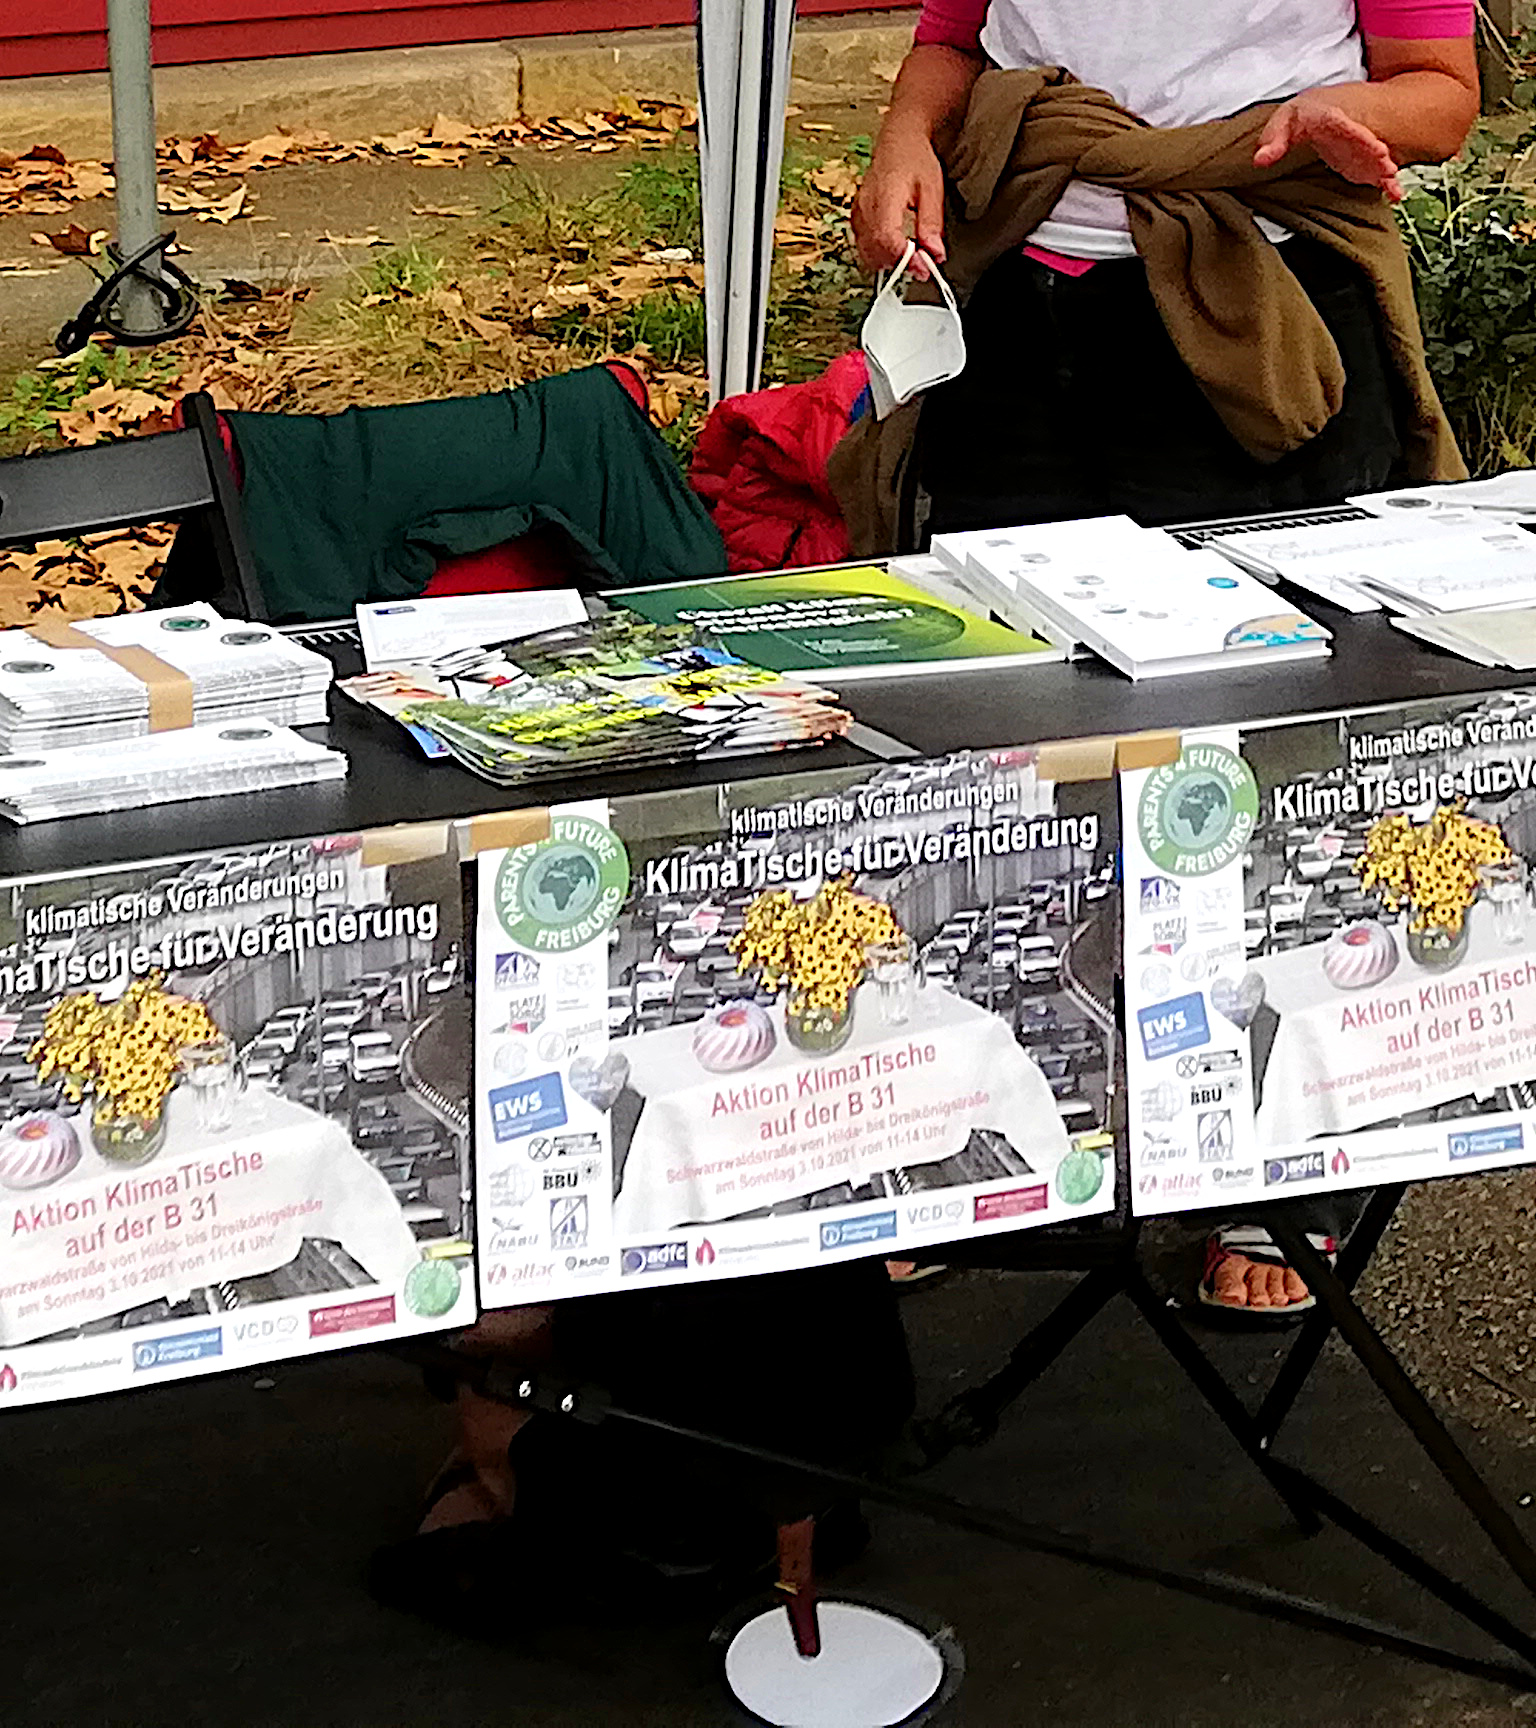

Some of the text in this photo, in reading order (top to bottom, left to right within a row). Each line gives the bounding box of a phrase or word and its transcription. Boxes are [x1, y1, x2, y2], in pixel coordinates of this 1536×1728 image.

[1349, 724, 1463, 762] klimatische
[730, 782, 1019, 836] klimatische Veränderungen
[1142, 748, 1247, 853] PARENTS FUTURE
[1273, 765, 1455, 822] KlimaTische
[553, 820, 618, 865] FUTURE
[645, 840, 842, 896] KlimaTische
[903, 813, 1100, 863] Veränderung
[1174, 810, 1251, 872] FREIBURG
[25, 870, 345, 936] klimatische Veränderungen
[217, 900, 439, 961] Veränderung
[534, 885, 621, 950] FREIBURG
[1142, 1009, 1188, 1042] EWS
[1339, 996, 1412, 1033] Aktion
[1386, 998, 1515, 1055] auf der B 31
[493, 1090, 543, 1122] EWS
[710, 1041, 937, 1119] Aktion KlimaTische
[759, 1081, 897, 1141] auf der B 31
[11, 1148, 265, 1238] Aktion KlimaTische
[64, 1192, 220, 1260] auf der B 31
